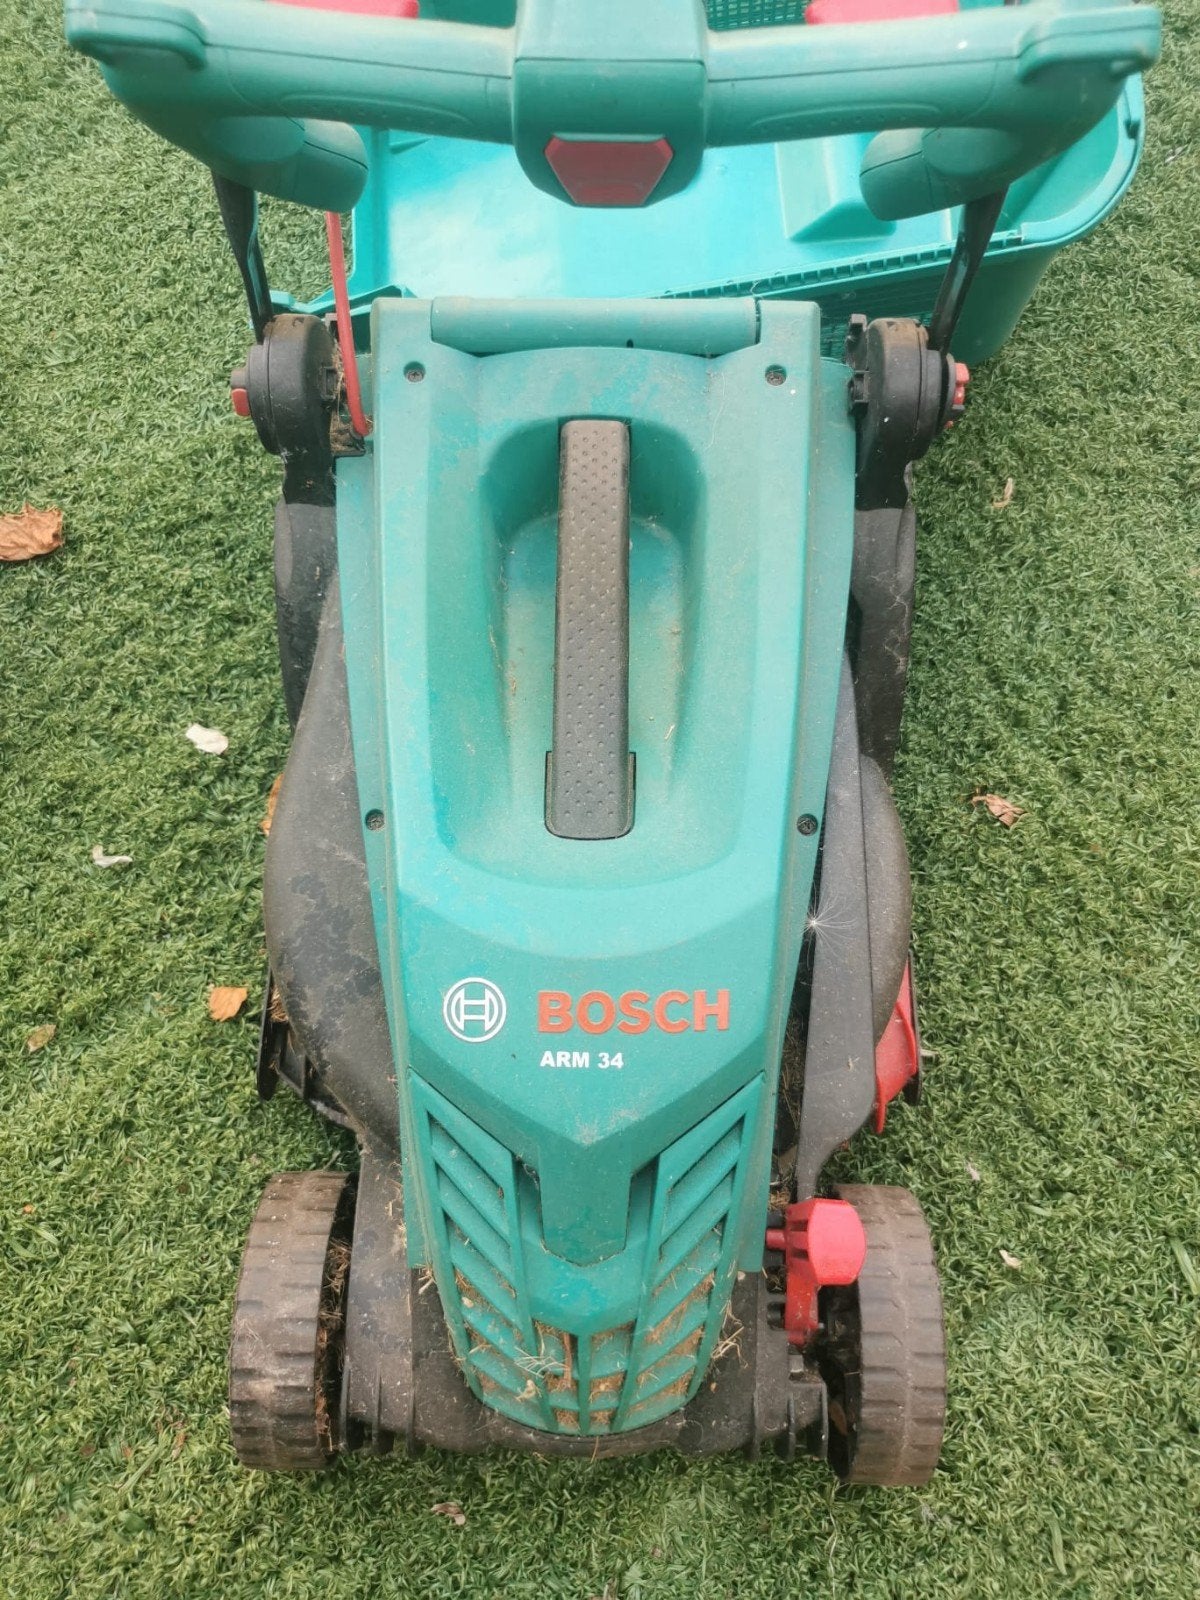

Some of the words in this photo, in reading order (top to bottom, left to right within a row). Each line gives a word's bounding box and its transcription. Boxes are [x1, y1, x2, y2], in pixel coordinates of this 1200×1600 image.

[537, 989, 731, 1035] BOSCH
[539, 1050, 590, 1068] ARM
[597, 1052, 624, 1069] 34
